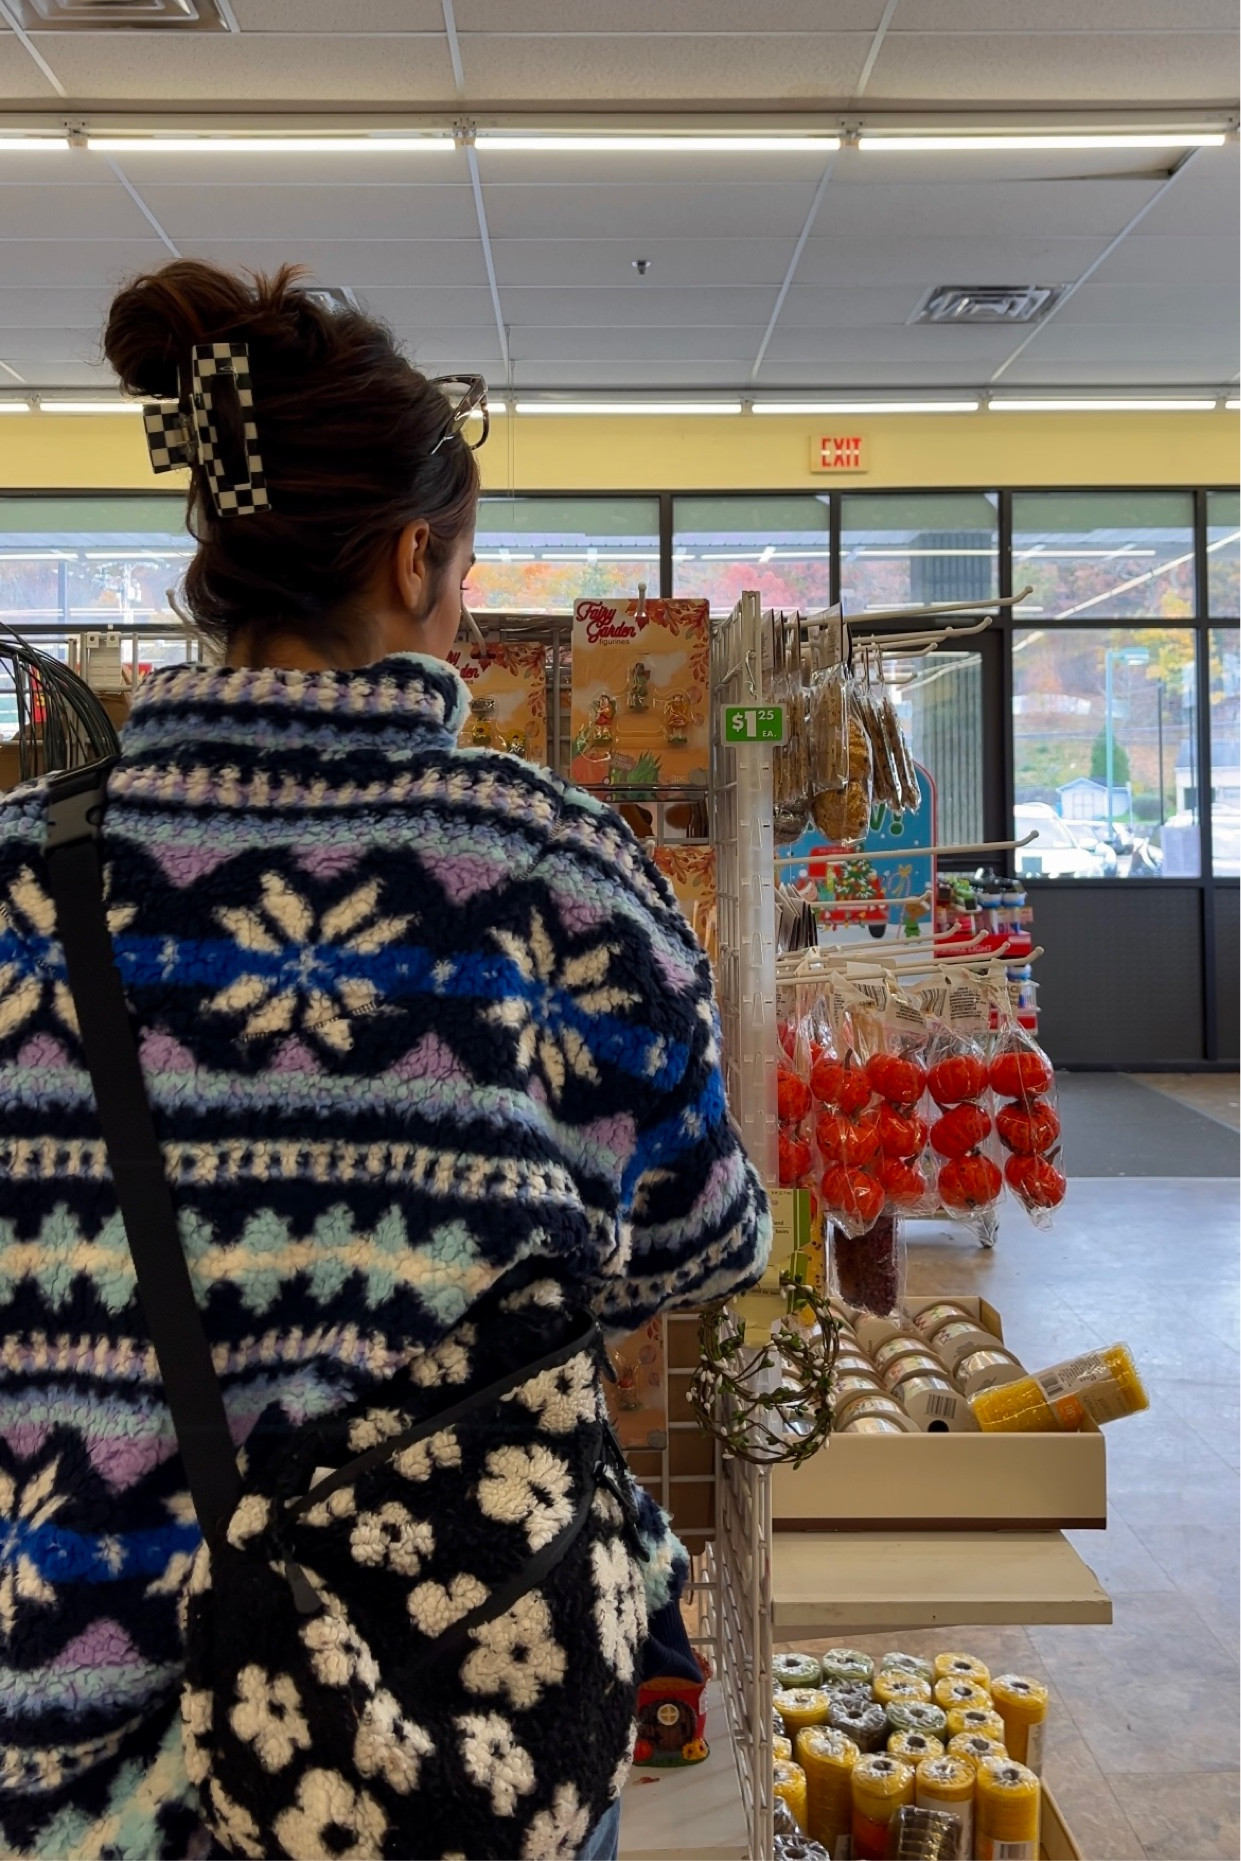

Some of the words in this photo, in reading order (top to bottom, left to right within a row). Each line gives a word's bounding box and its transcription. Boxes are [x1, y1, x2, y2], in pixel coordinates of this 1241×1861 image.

[821, 437, 862, 467] EXIT
[576, 601, 617, 628] Fairy
[586, 621, 636, 643] Garden
[599, 638, 630, 646] figurines
